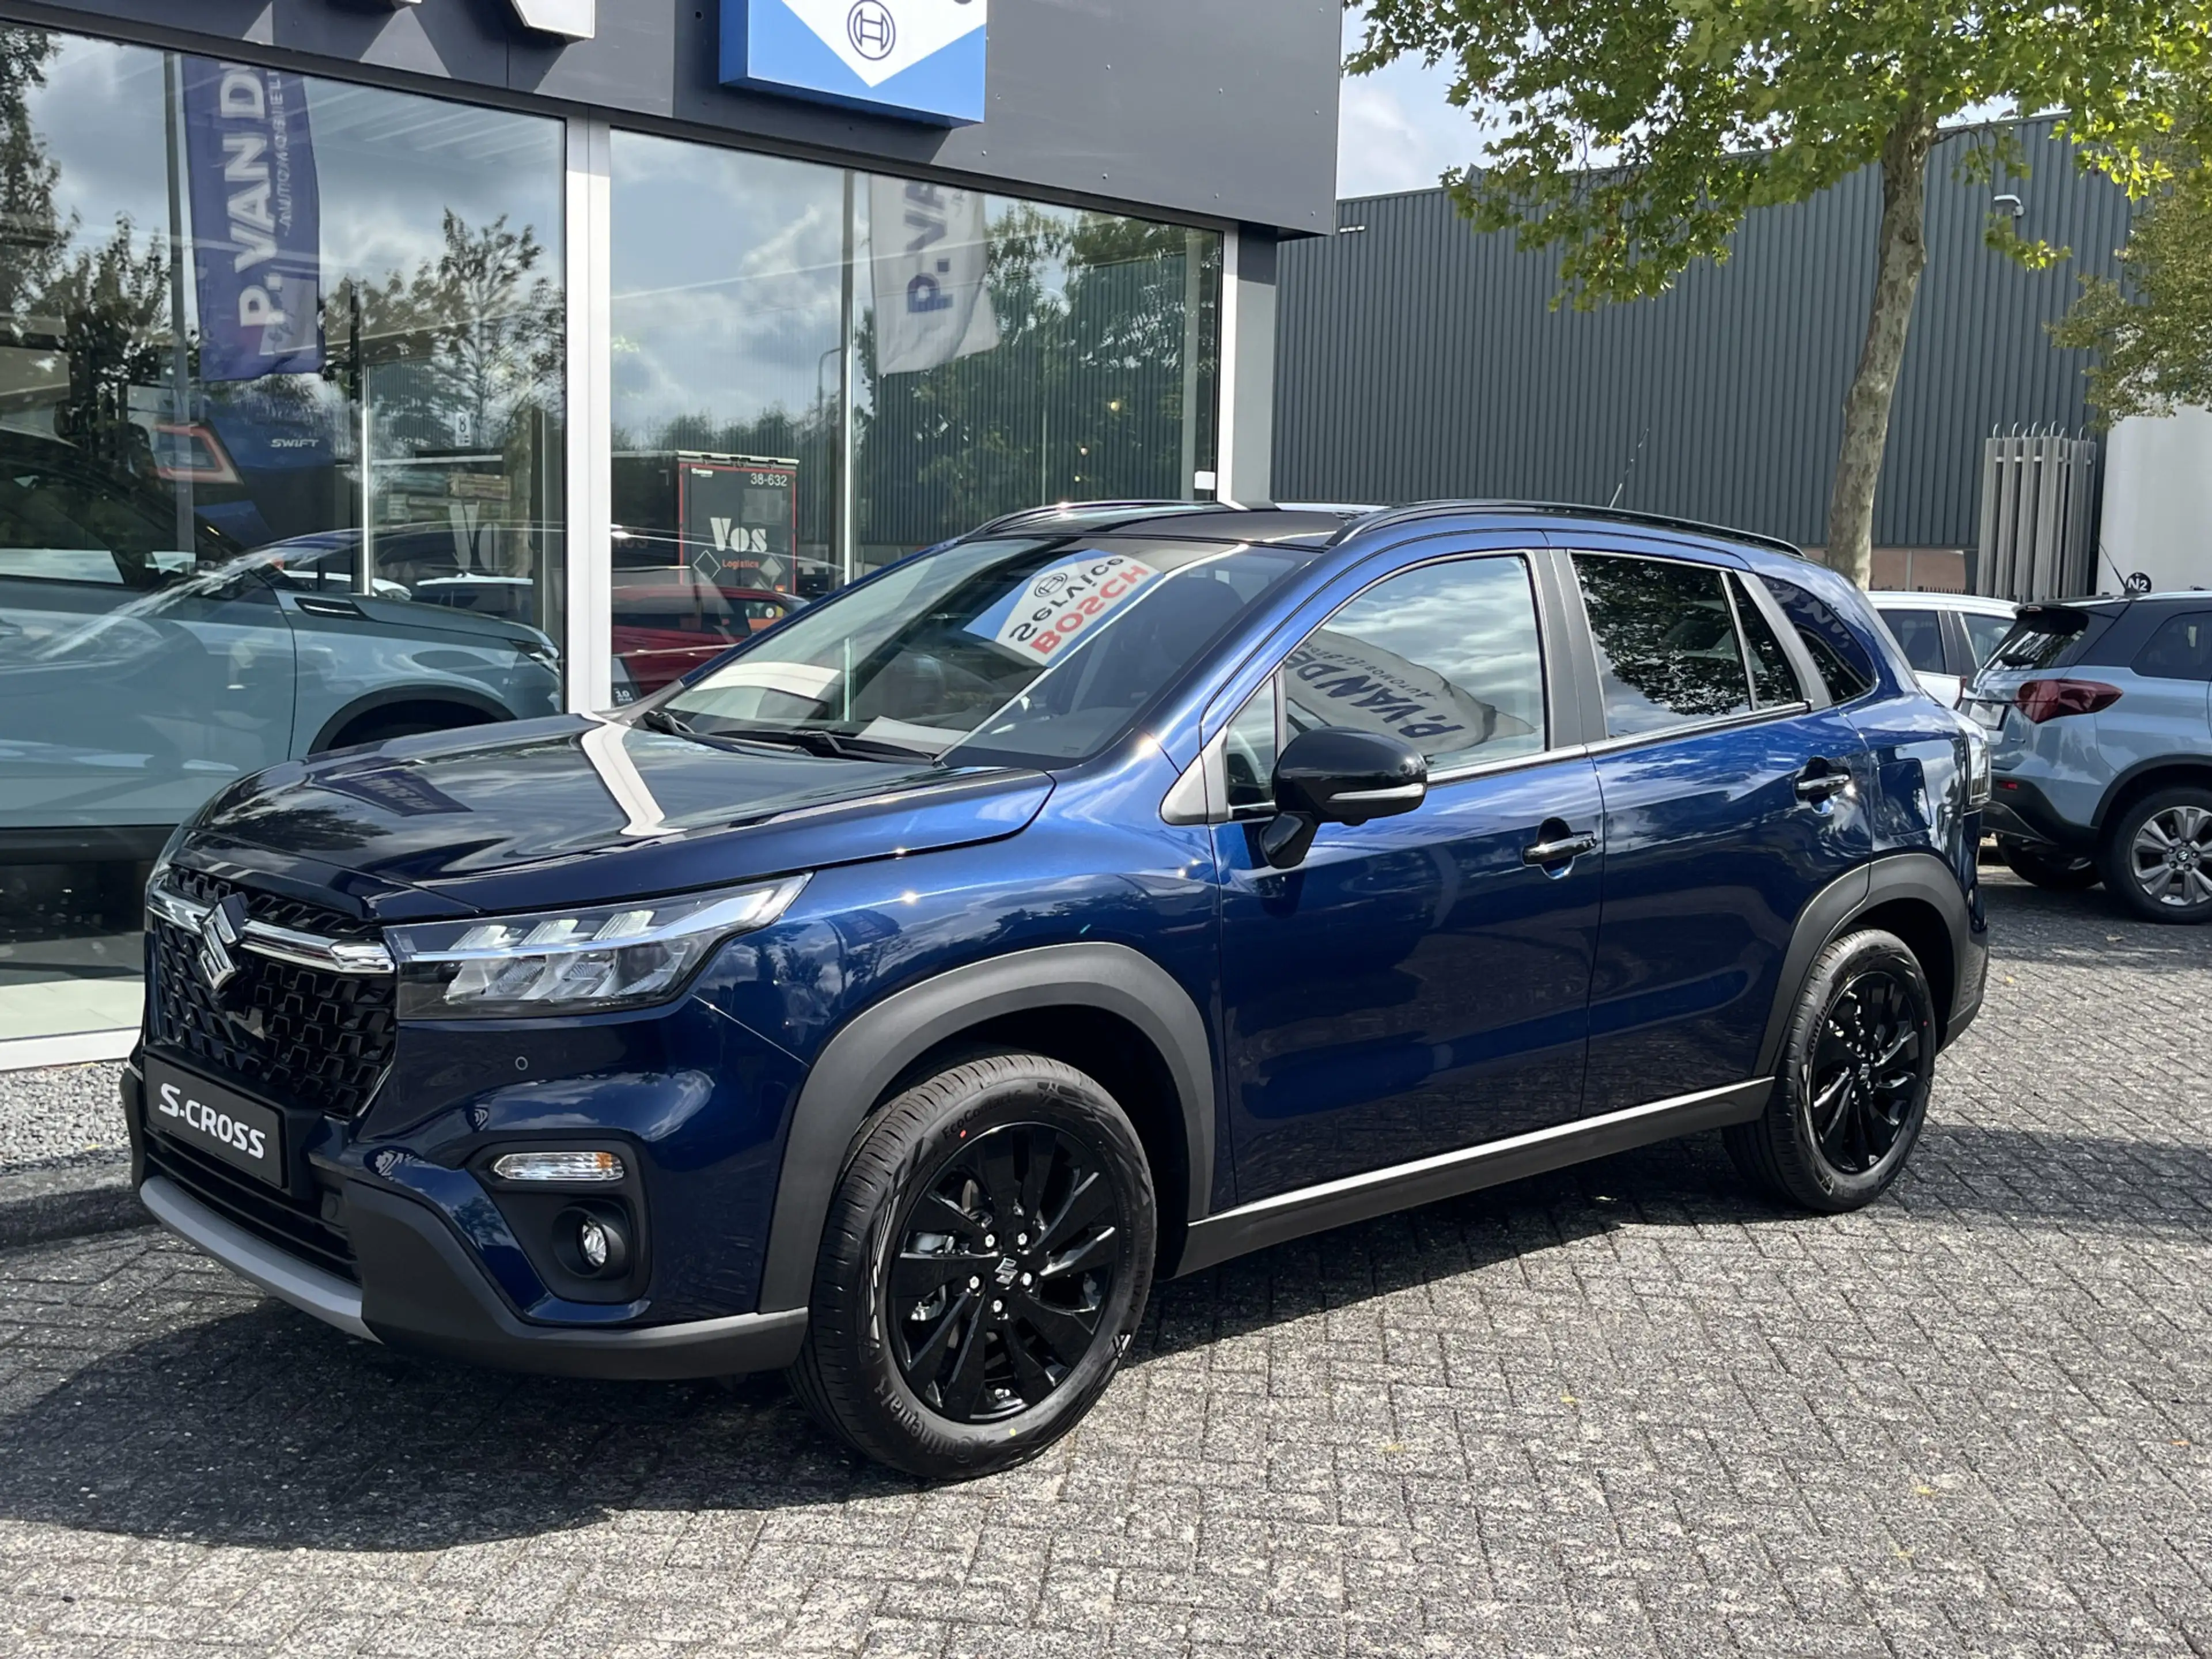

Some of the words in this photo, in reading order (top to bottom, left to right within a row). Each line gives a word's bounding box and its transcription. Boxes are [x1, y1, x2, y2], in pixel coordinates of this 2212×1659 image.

[270, 438, 319, 448] SWIFT
[751, 473, 787, 486] 38-632
[710, 517, 767, 552] Vos
[722, 559, 759, 569] Logistics
[2128, 578, 2147, 590] N2
